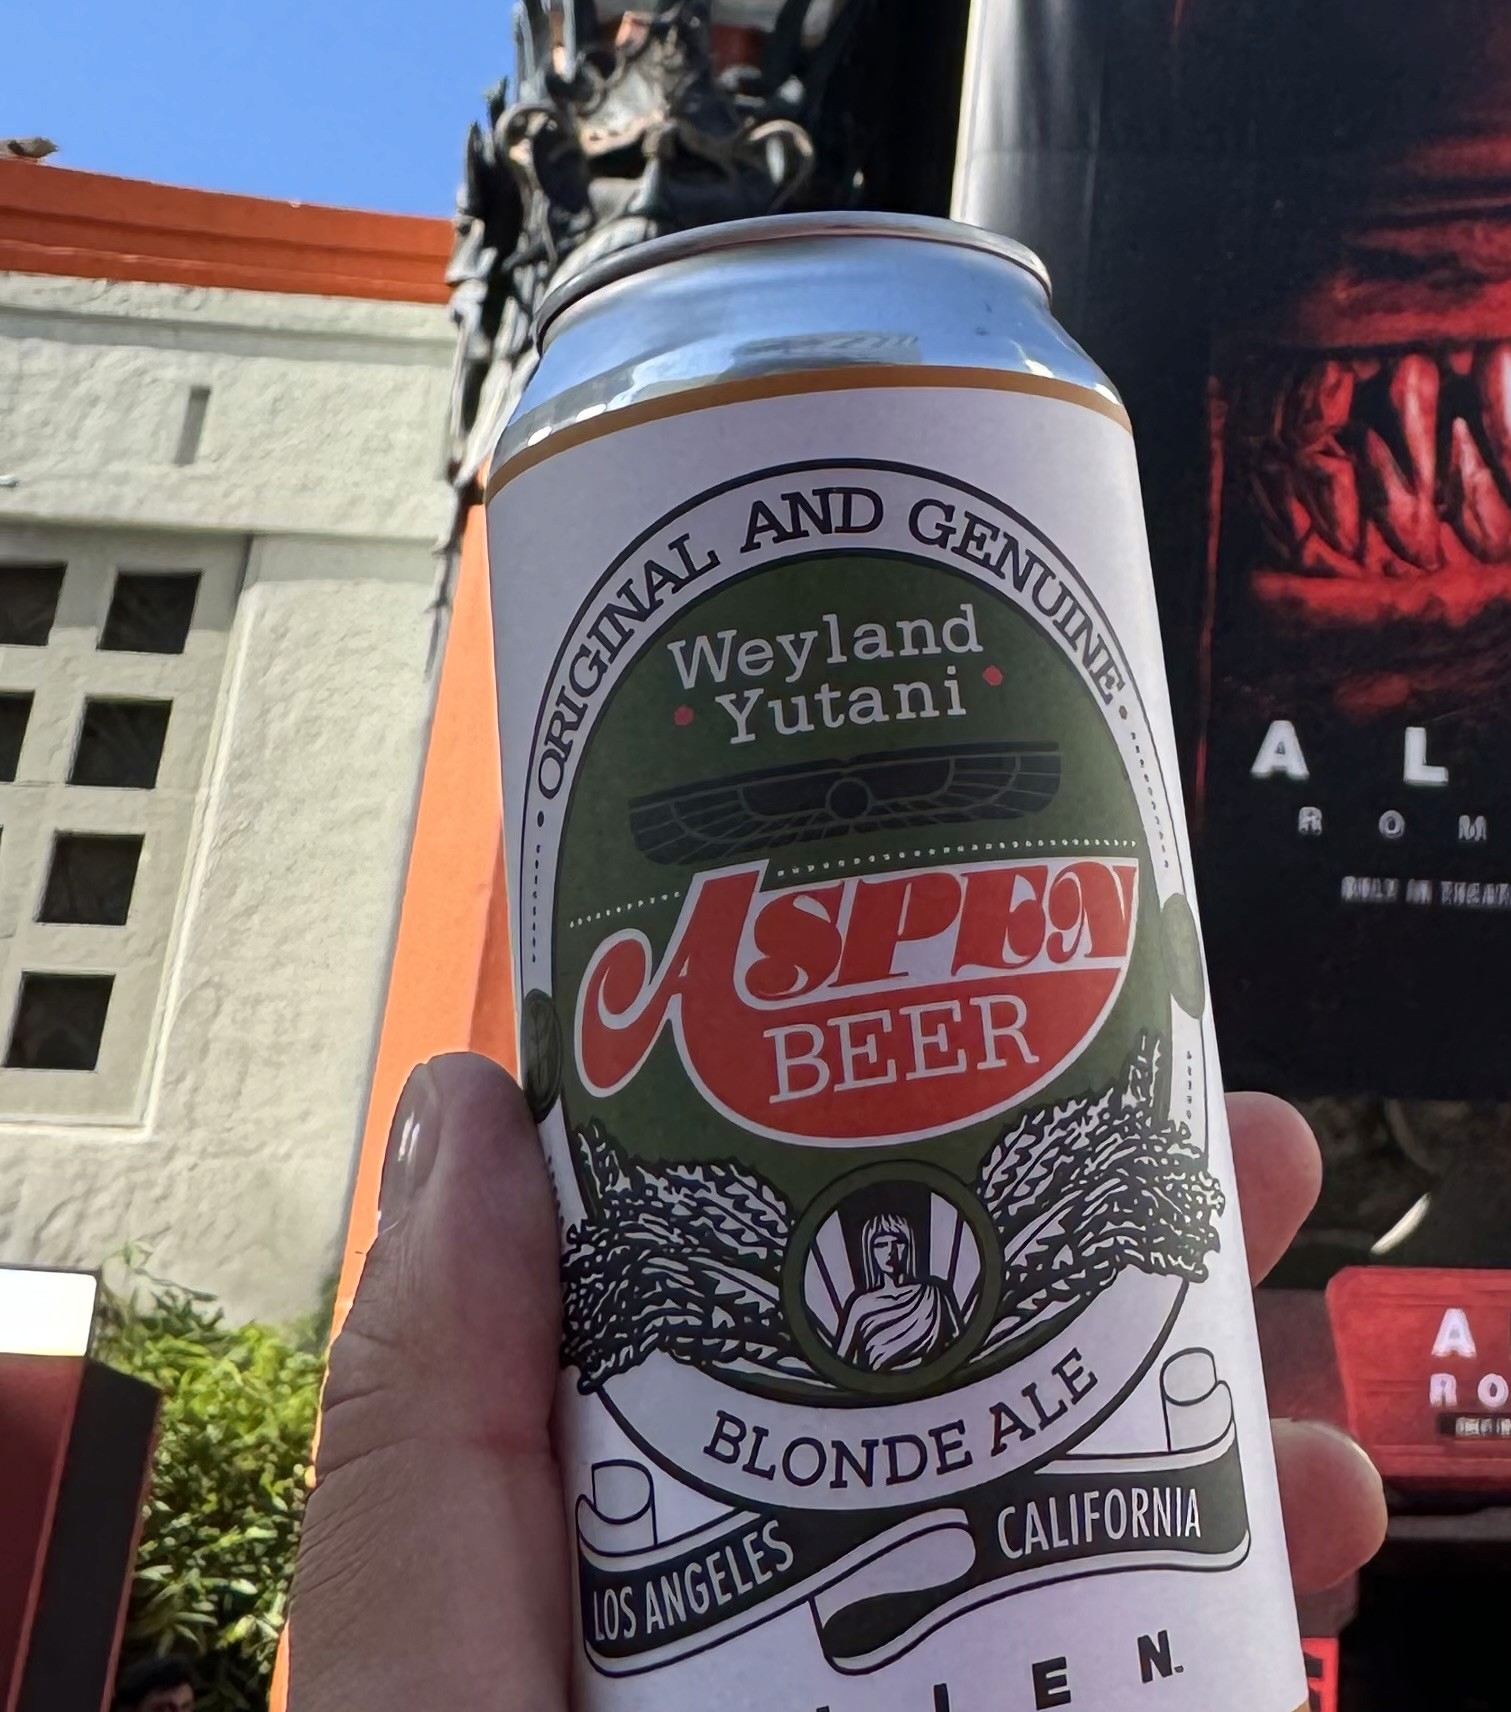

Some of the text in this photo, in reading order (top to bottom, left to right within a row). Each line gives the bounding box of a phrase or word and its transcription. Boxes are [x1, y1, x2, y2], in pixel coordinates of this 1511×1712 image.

[537, 487, 1128, 798] ORIGINAL AND GENUINE
[667, 604, 984, 688] Weyland
[714, 666, 967, 745] Yutani
[575, 860, 1139, 1098] ASPEN
[763, 994, 1039, 1104] BEER
[702, 1347, 1098, 1490] BLONDE ALE
[594, 1520, 795, 1642] LOS ANGELES
[996, 1488, 1202, 1559] CALIFORNIA
